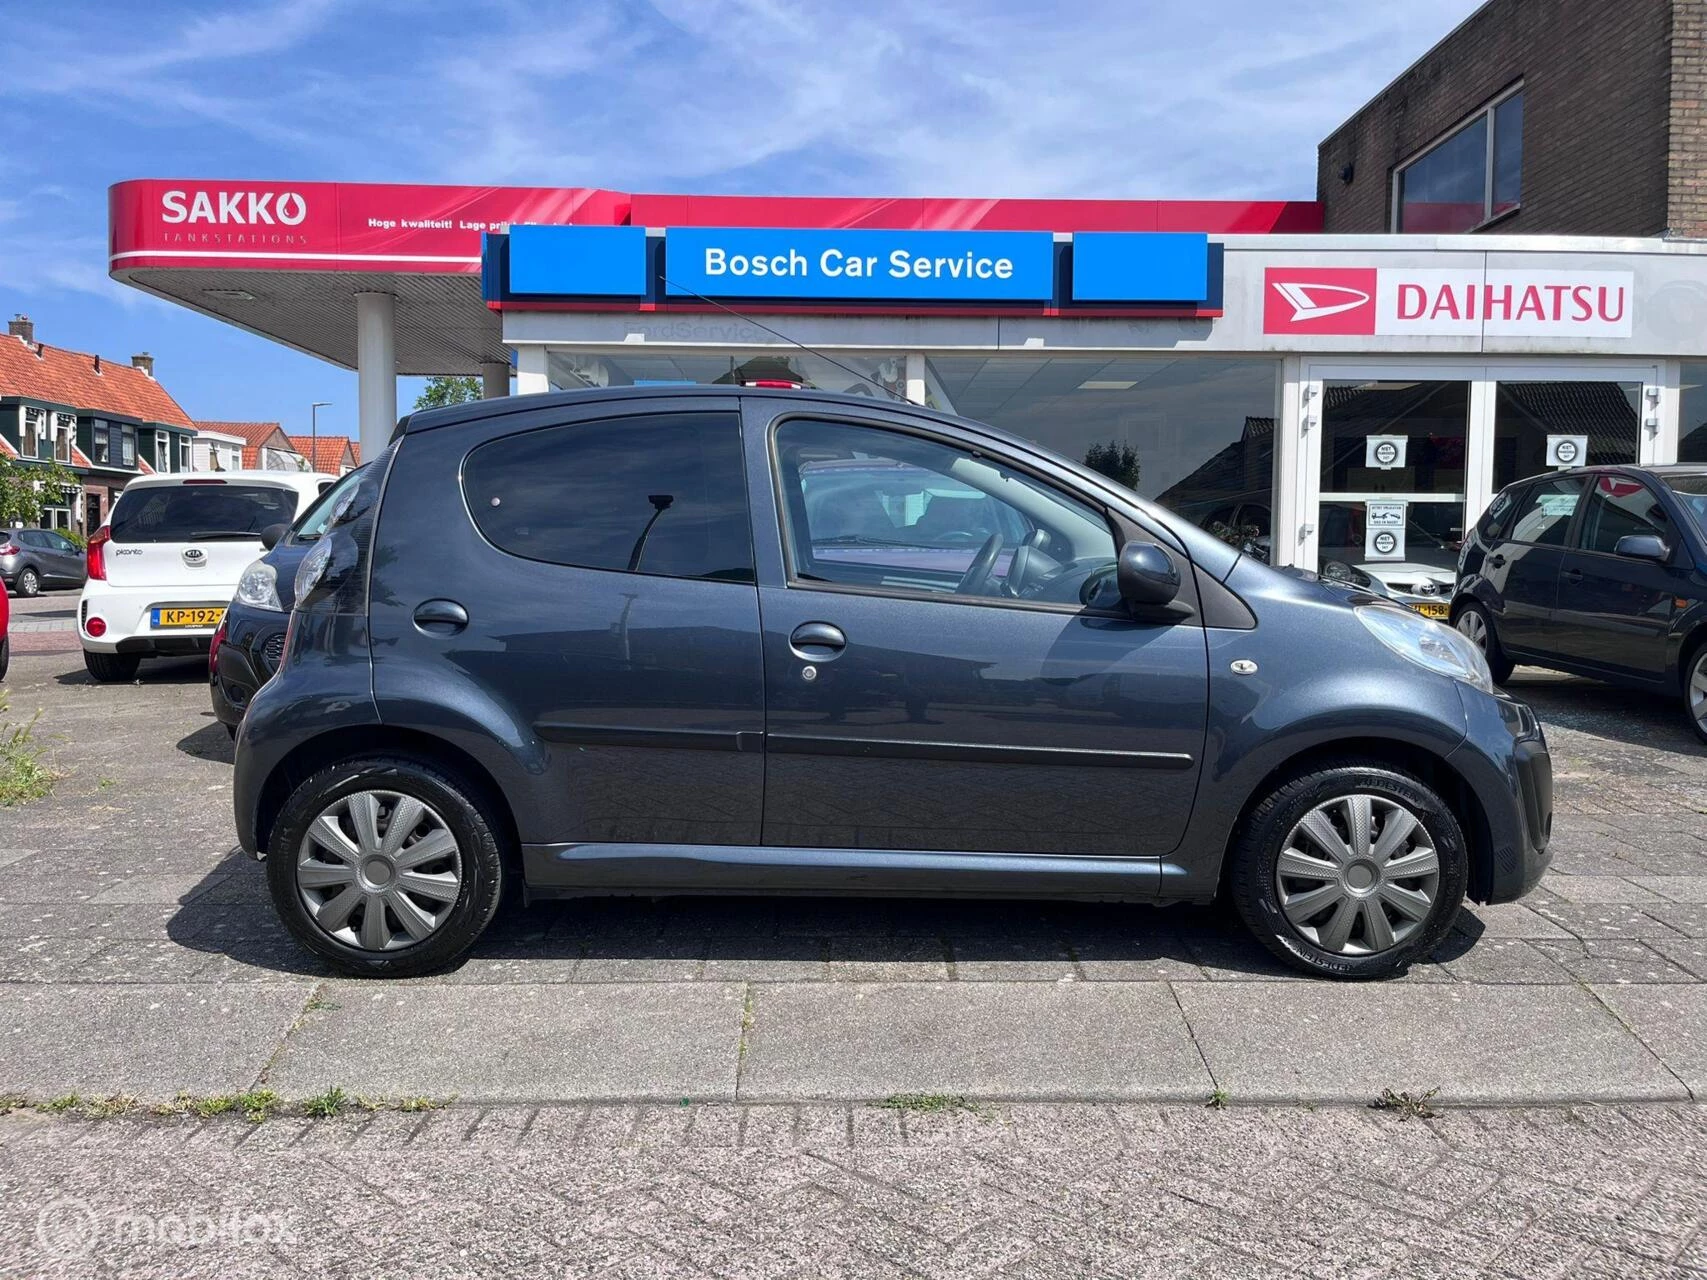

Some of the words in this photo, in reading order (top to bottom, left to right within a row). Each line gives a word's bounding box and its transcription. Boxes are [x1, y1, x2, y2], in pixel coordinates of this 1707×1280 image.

[162, 190, 307, 225] SAKKO
[368, 218, 396, 229] Hoge
[401, 219, 452, 229] kwaliteit!
[459, 220, 486, 231] Lage
[163, 232, 308, 245] TANKSTATIONS
[705, 247, 807, 277] Bosch
[819, 248, 878, 278] Car
[888, 249, 1014, 280] Service
[1398, 283, 1625, 323] DAIHATSU
[186, 549, 202, 558] KIA
[166, 610, 225, 623] KP-192-
